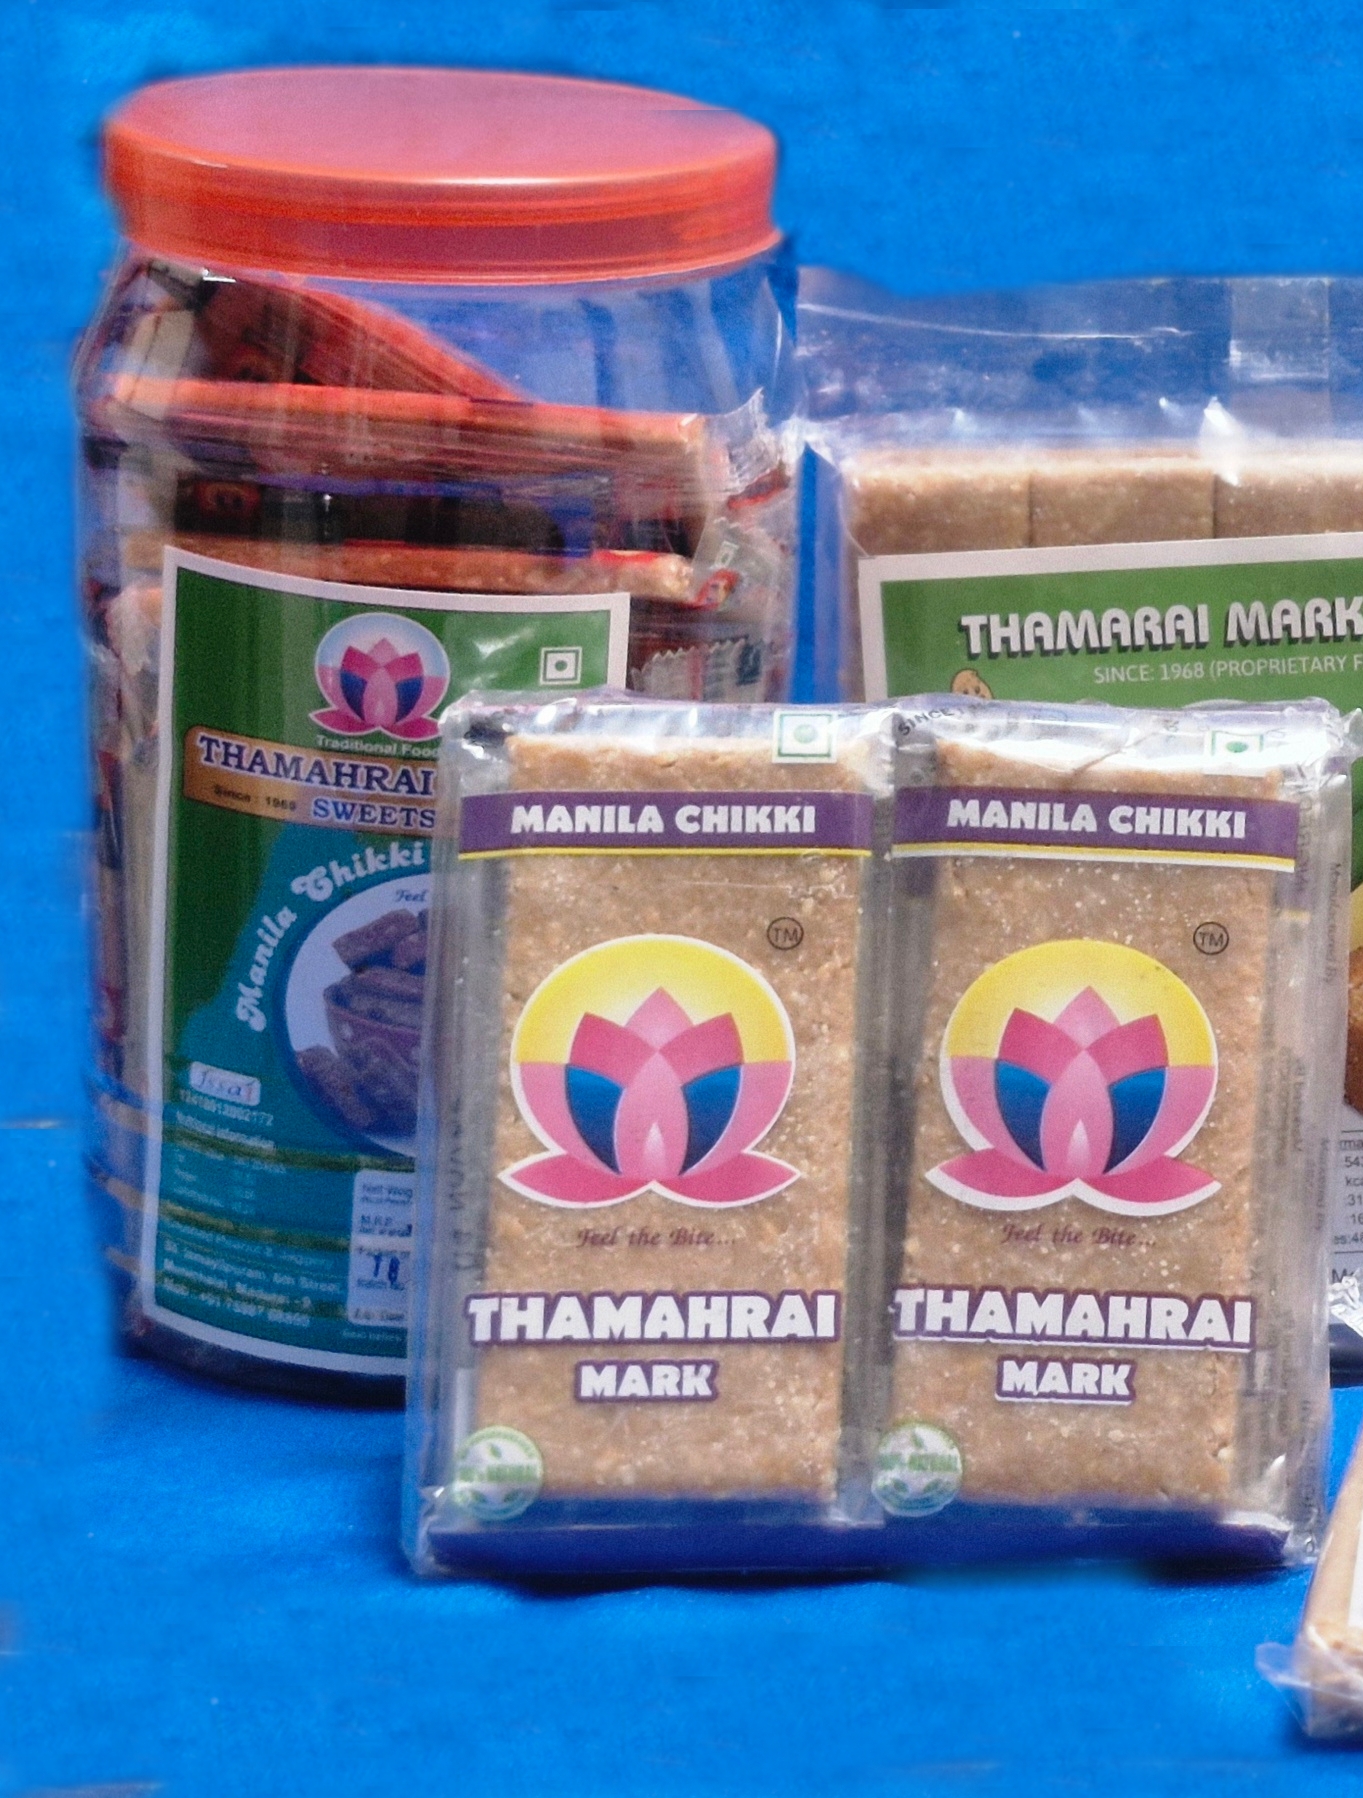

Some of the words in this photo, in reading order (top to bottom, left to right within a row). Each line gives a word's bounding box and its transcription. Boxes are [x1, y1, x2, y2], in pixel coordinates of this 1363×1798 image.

[960, 605, 1210, 659] THAMARAI
[1093, 662, 1155, 685] SINCE:
[1159, 660, 1205, 682] 1968
[1209, 654, 1348, 682] (PROPRIETARY
[316, 733, 397, 756] Traditional
[199, 734, 436, 797] THAMAHRAI
[311, 797, 437, 830] SWEETS
[510, 804, 665, 835] MANILA
[674, 804, 817, 835] CHIKKI
[947, 798, 1098, 834] MANILA
[1108, 805, 1247, 840] CHIKKI
[290, 841, 425, 902] Chikki
[773, 925, 800, 943] TM
[1198, 930, 1225, 948] TM
[628, 1228, 661, 1247] the
[1051, 1225, 1083, 1245] the
[466, 1293, 837, 1342] THAMAHRAI
[894, 1287, 1255, 1345] THAMAHRAI
[579, 1363, 714, 1398] MARK
[1000, 1360, 1133, 1397] MARK
